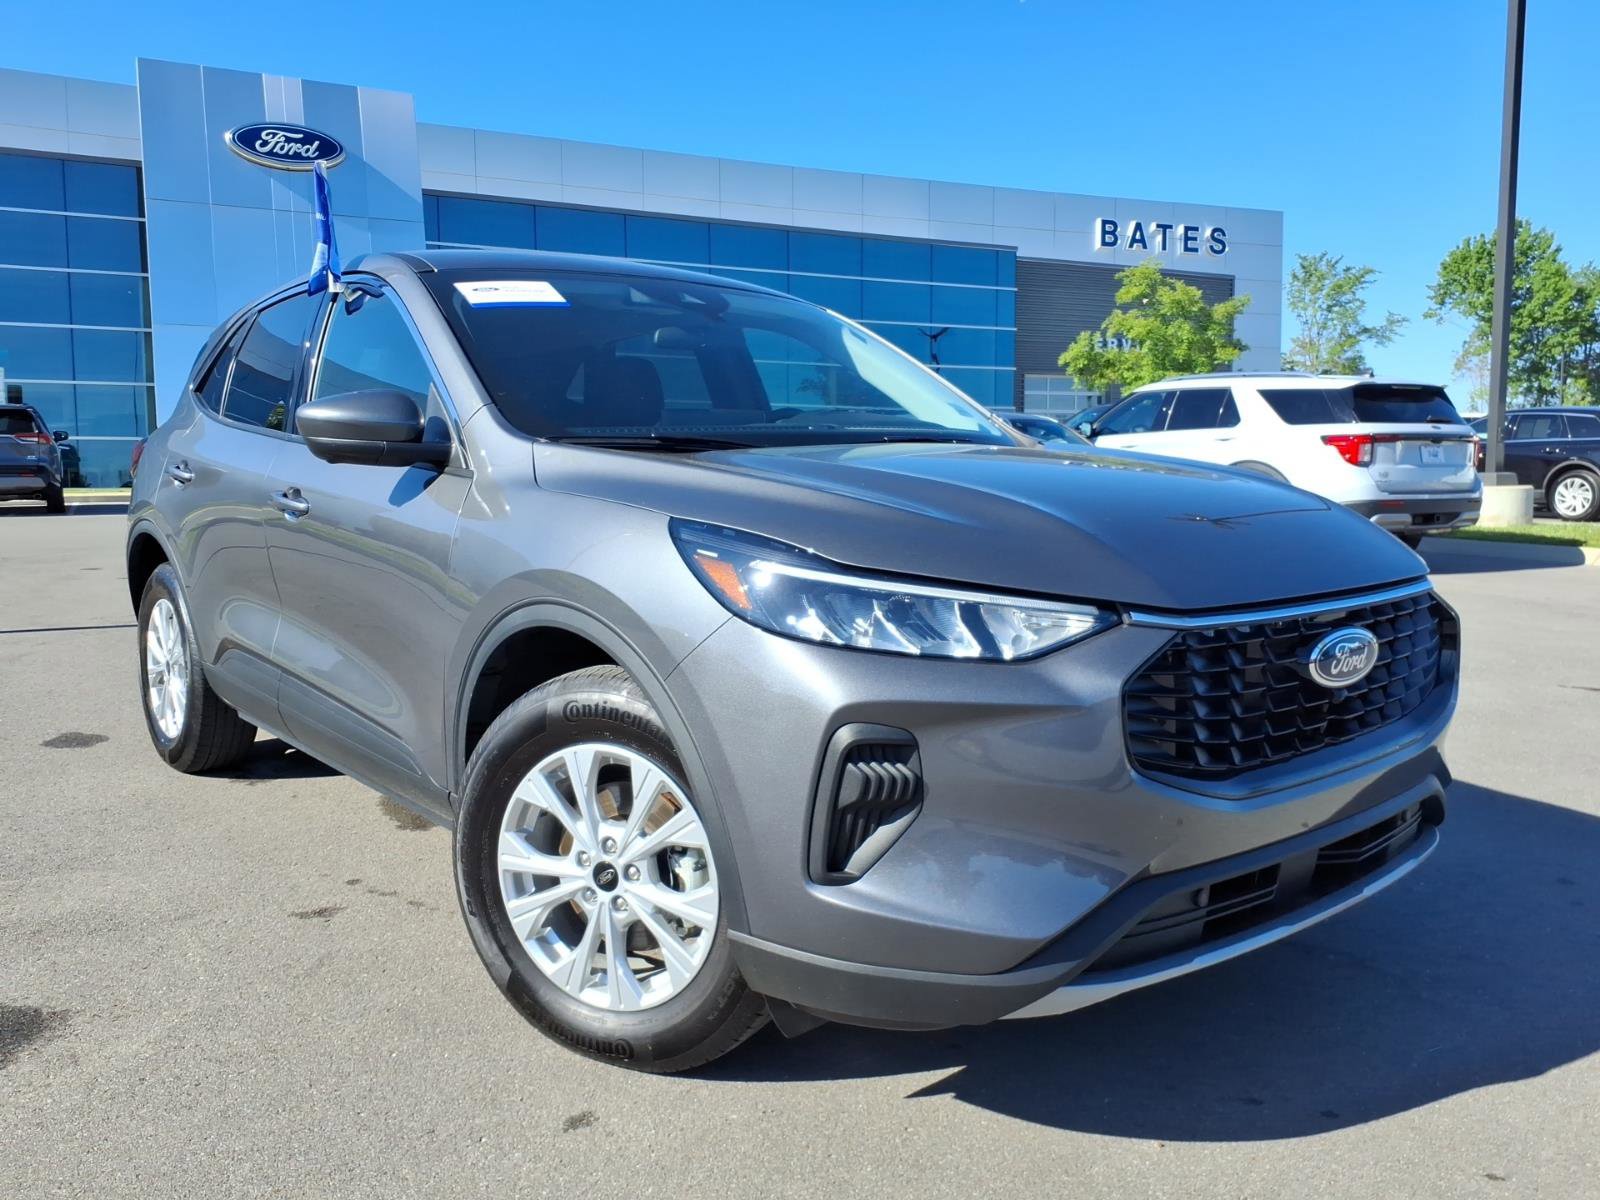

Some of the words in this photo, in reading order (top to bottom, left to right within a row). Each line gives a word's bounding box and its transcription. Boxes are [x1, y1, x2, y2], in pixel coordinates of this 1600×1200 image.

[255, 129, 320, 158] Ford
[1099, 218, 1228, 255] BATES
[1331, 641, 1368, 675] Ford
